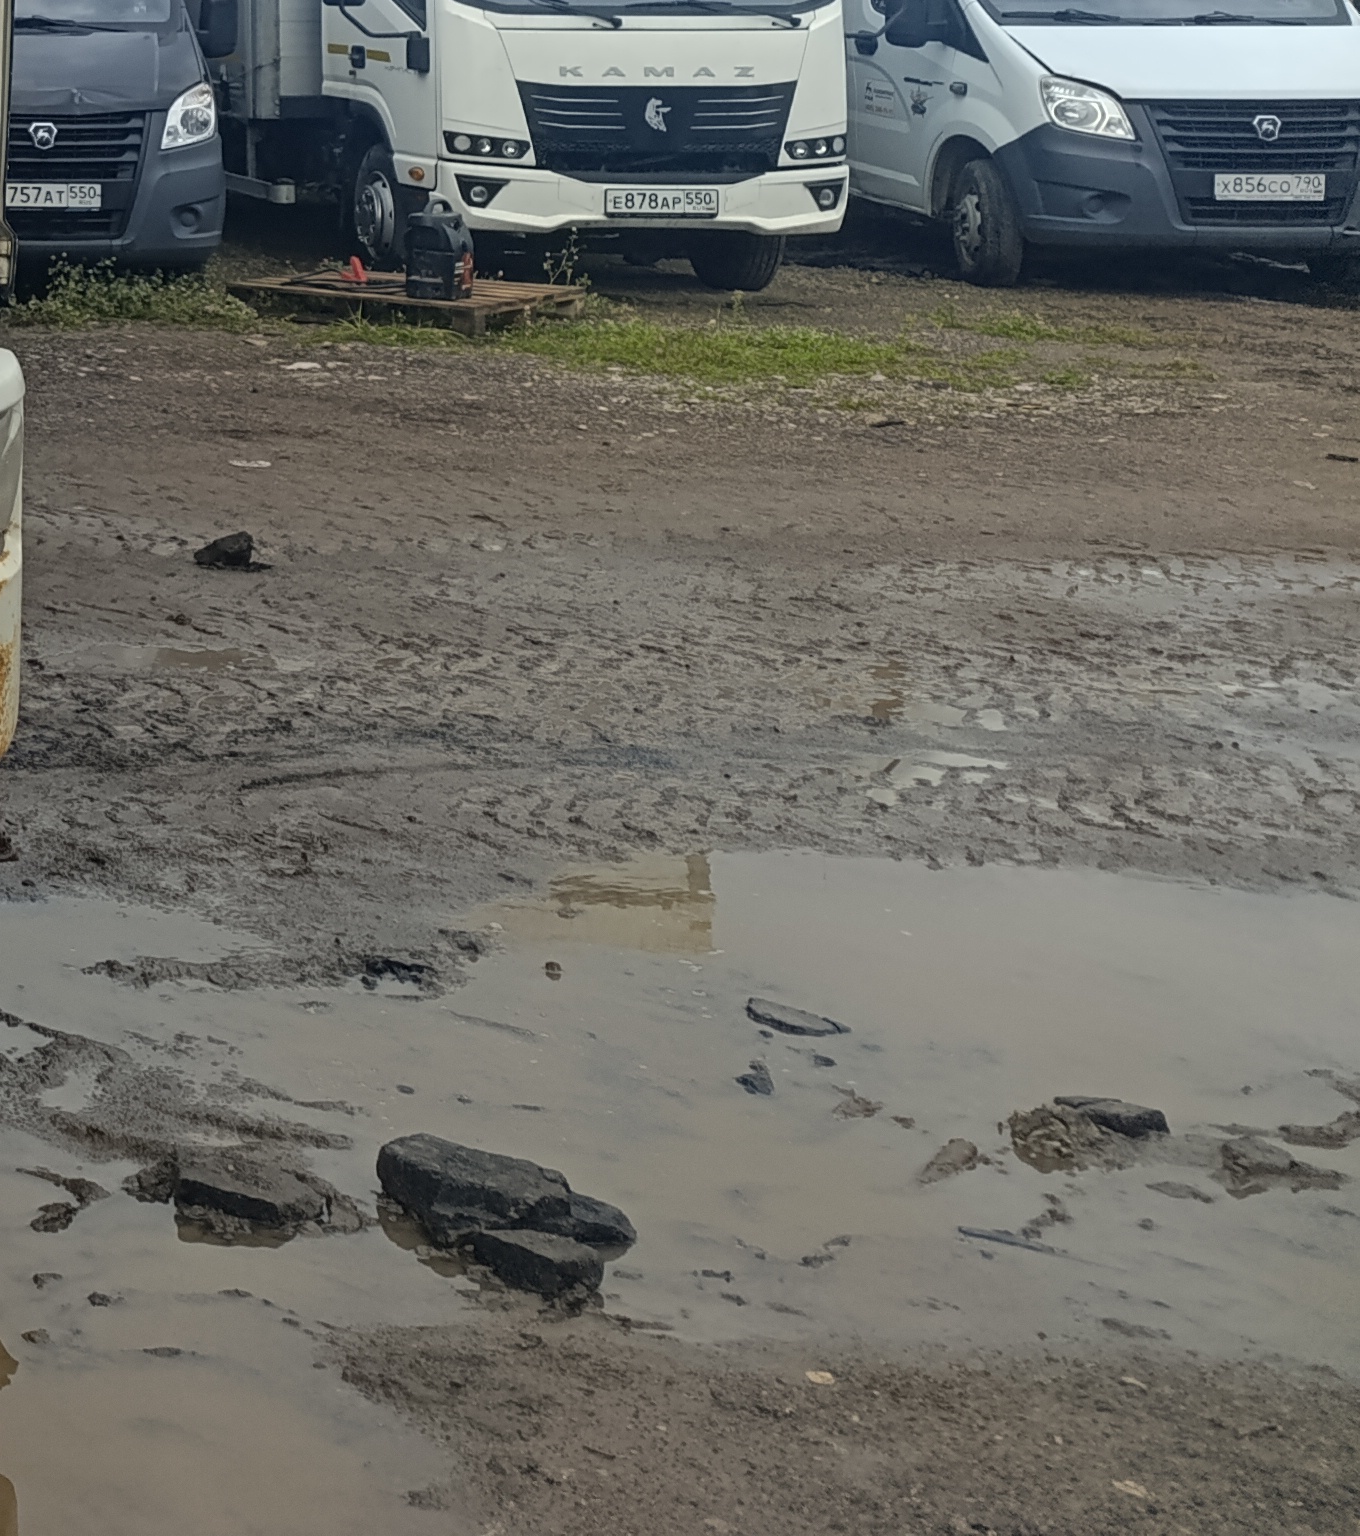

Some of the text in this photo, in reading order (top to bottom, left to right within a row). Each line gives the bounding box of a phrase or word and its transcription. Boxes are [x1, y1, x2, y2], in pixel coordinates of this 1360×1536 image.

[559, 65, 755, 78] KAMAZ
[8, 185, 97, 204] 757АТ 550
[685, 192, 712, 205] 550
